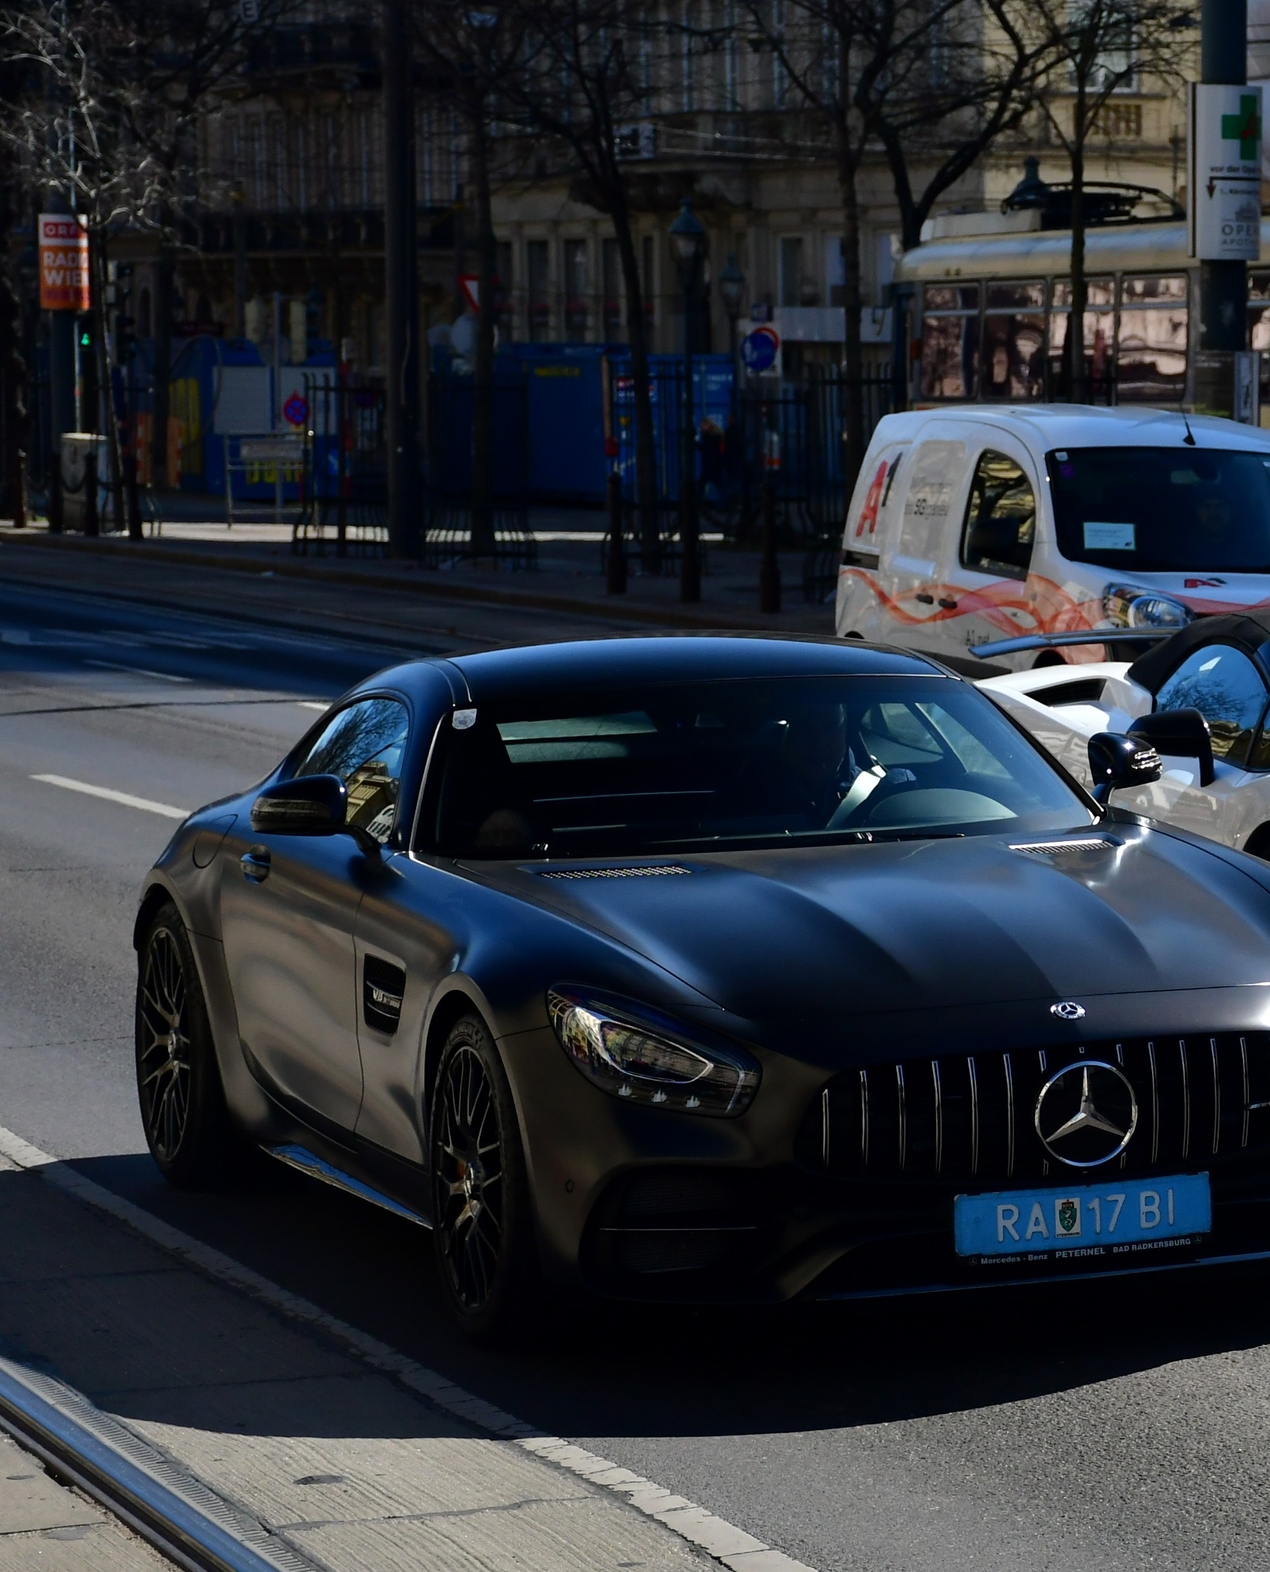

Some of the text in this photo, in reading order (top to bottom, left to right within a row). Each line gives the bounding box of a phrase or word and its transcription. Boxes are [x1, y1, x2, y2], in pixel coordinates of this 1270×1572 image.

[856, 451, 903, 538] A1
[996, 1188, 1175, 1243] RA 17 BI
[980, 1255, 1021, 1266] Mercedes
[1027, 1252, 1049, 1263] Benz
[1055, 1247, 1106, 1259] PETERNEL
[1112, 1244, 1130, 1254] BAD
[1131, 1237, 1192, 1253] RADKERSBURG
